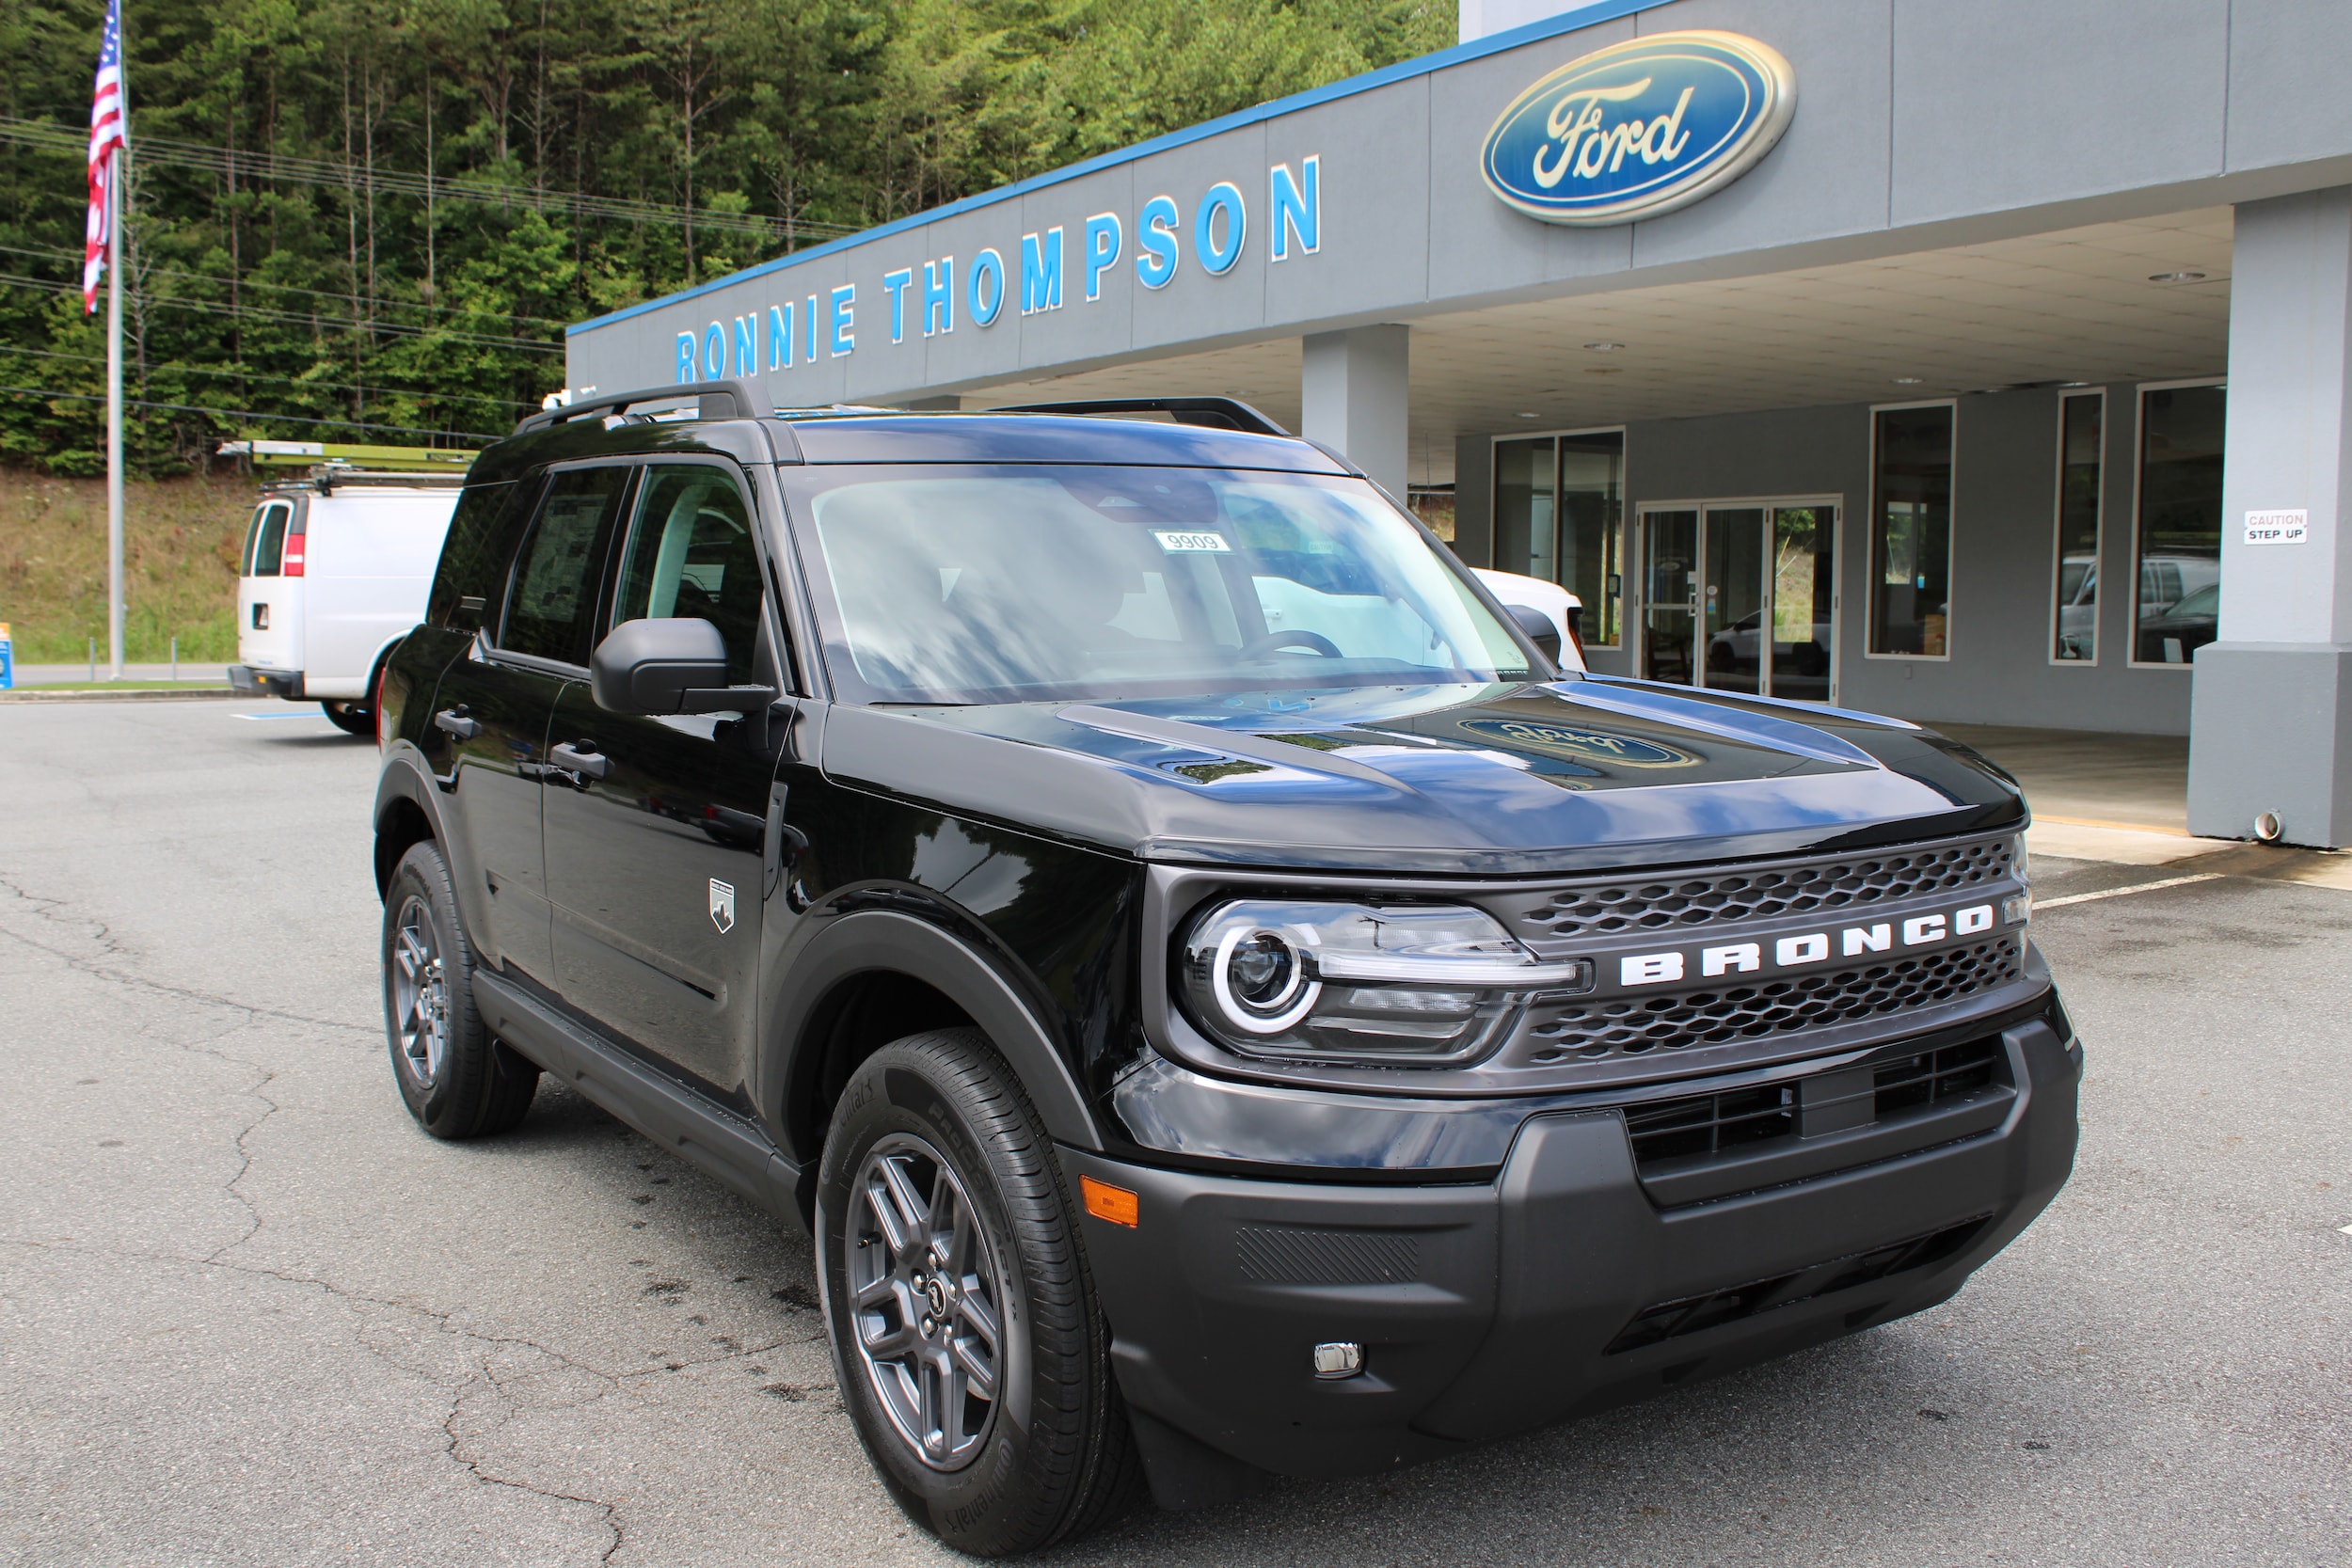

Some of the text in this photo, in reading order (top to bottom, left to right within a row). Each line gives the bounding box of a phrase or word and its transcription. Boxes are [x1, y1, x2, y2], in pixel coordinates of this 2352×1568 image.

[1533, 77, 1694, 188] Ford
[675, 153, 1322, 384] RONNIE THOMPSON
[1168, 534, 1218, 549] 9909
[2249, 515, 2304, 526] CAUTION
[2249, 530, 2303, 540] STEP UP
[1620, 904, 1994, 987] BRONCO
